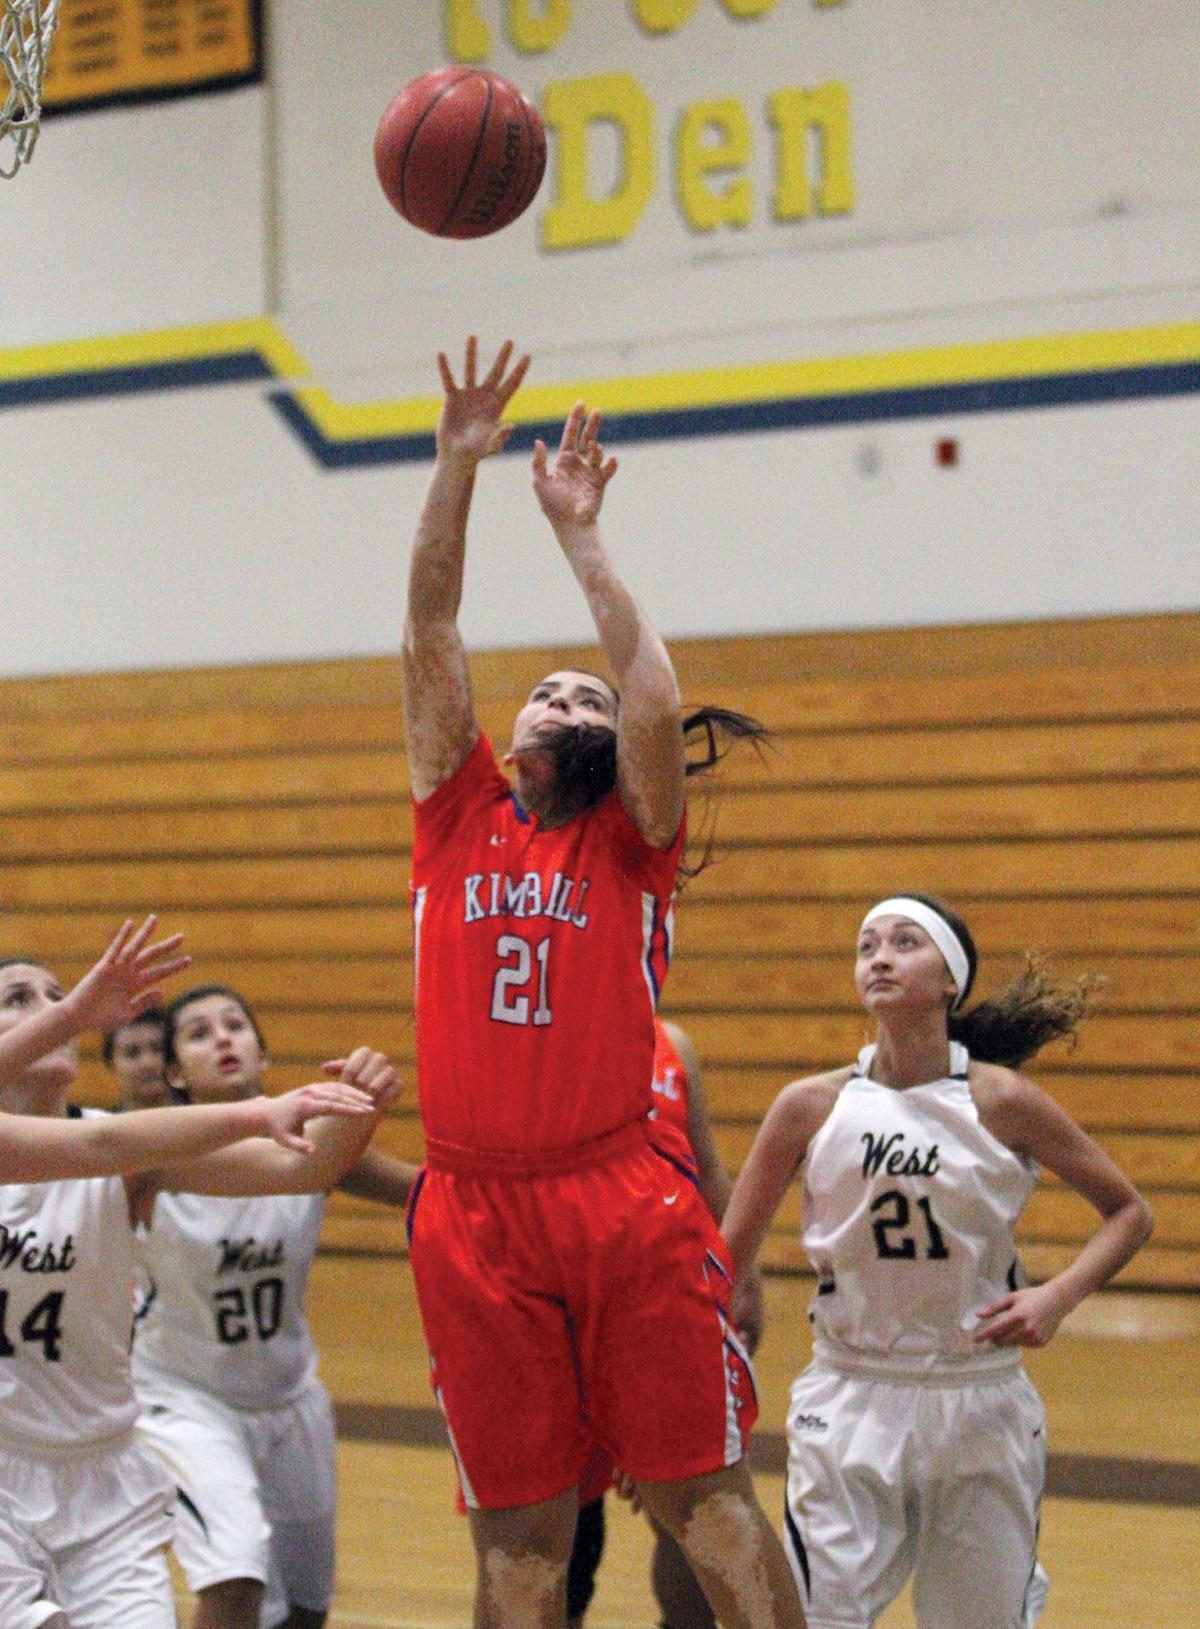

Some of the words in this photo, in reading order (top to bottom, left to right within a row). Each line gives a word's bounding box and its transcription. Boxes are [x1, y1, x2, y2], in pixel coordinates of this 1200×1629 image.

[540, 70, 856, 250] Den
[490, 933, 552, 1027] 21
[861, 1132, 940, 1178] West
[0, 1224, 76, 1272] West
[216, 1237, 284, 1278] West
[870, 1189, 949, 1260] 21
[0, 1288, 65, 1361] 14
[214, 1278, 284, 1343] 20
